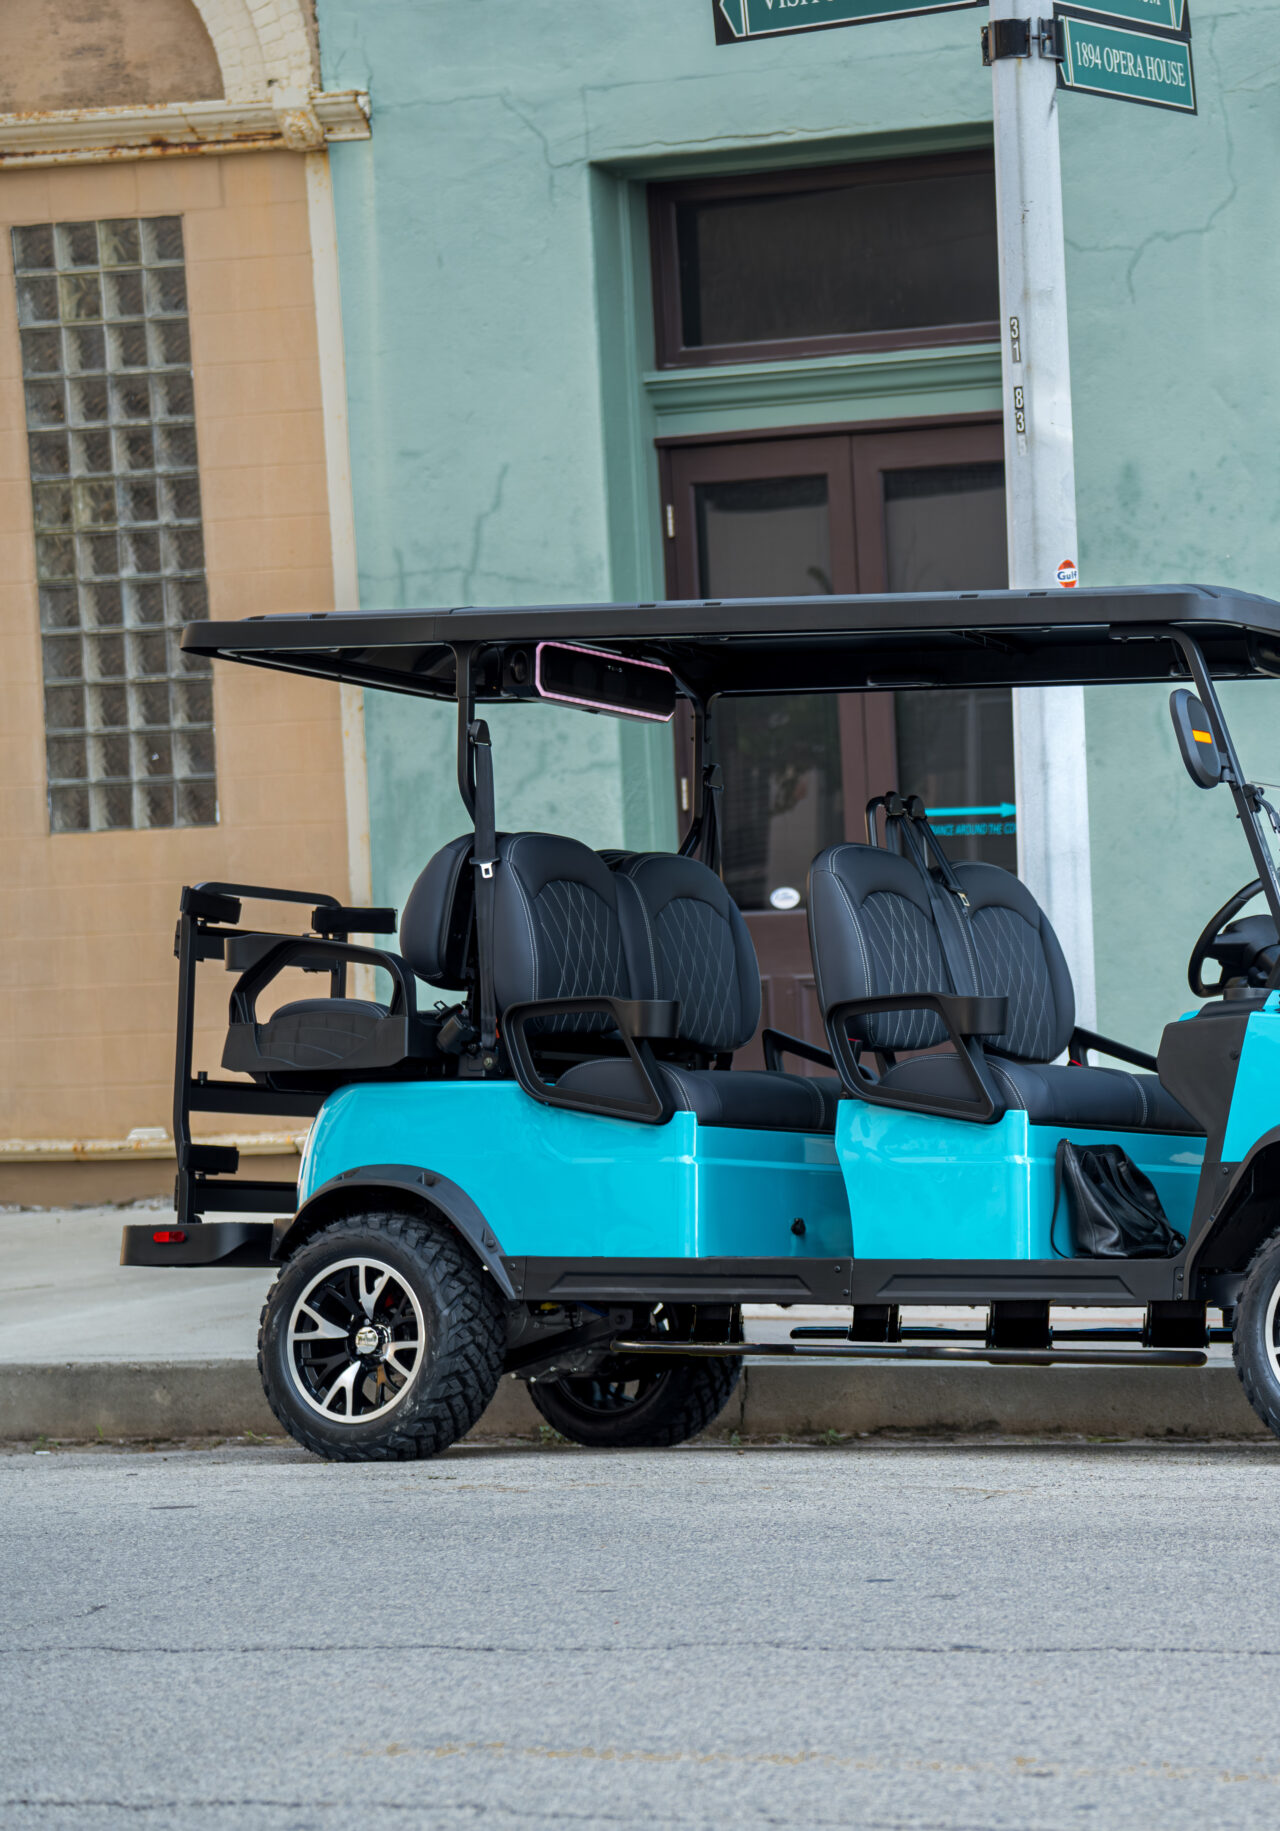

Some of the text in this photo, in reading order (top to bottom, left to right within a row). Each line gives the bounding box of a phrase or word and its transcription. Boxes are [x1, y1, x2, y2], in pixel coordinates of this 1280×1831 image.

[1075, 41, 1186, 87] 1894 OPERA HOUSE
[1057, 570, 1077, 580] Gulf
[988, 823, 1002, 835] THE
